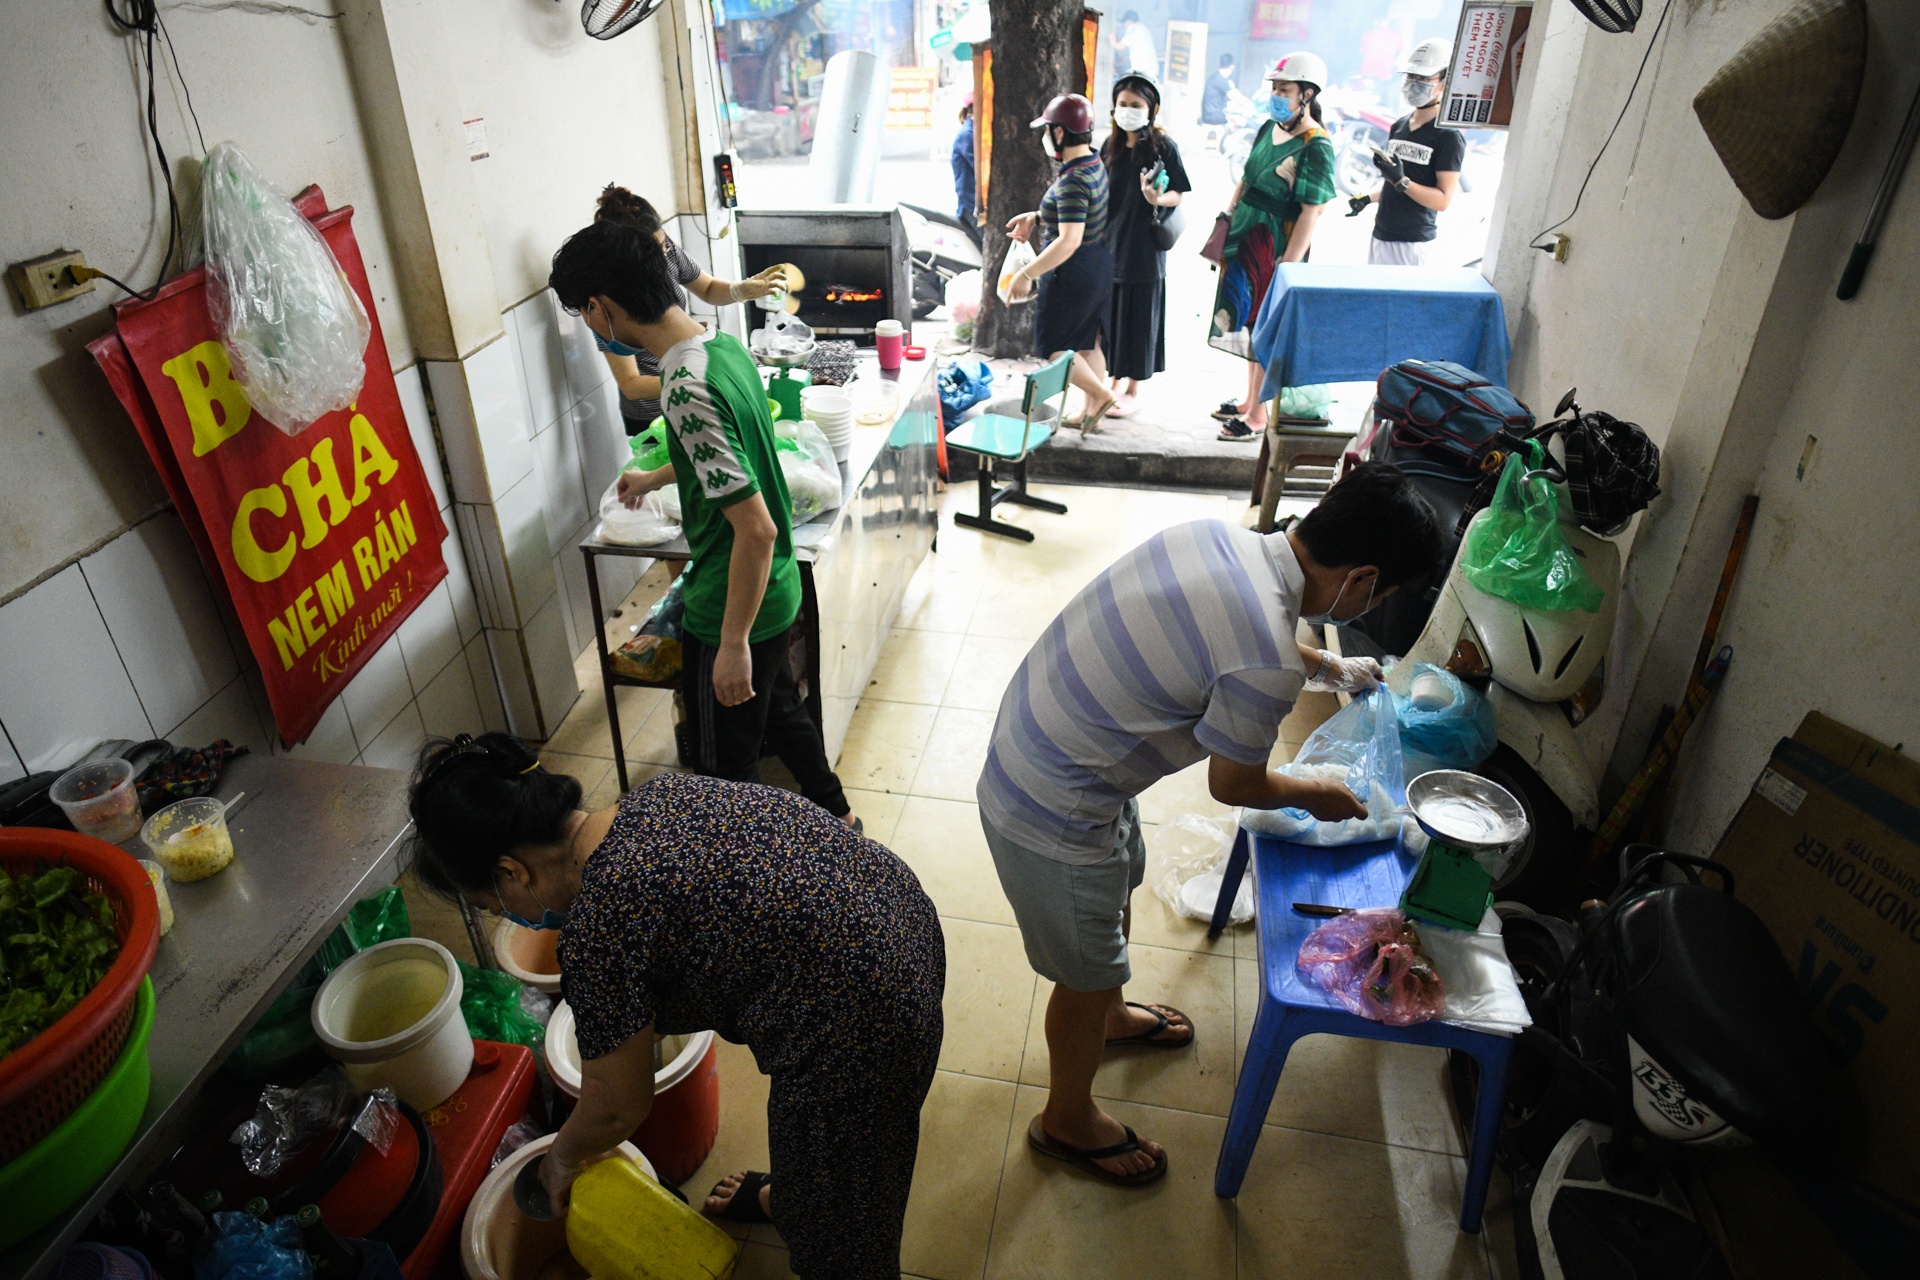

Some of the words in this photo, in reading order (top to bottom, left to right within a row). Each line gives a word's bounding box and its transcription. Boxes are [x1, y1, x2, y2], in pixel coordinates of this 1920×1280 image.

[1475, 40, 1488, 73] NGON
[267, 559, 355, 672] NEM
[352, 499, 417, 592] RÁN
[312, 615, 367, 684] Kính
[371, 582, 402, 629] mời
[1845, 837, 1873, 864] TYPE
